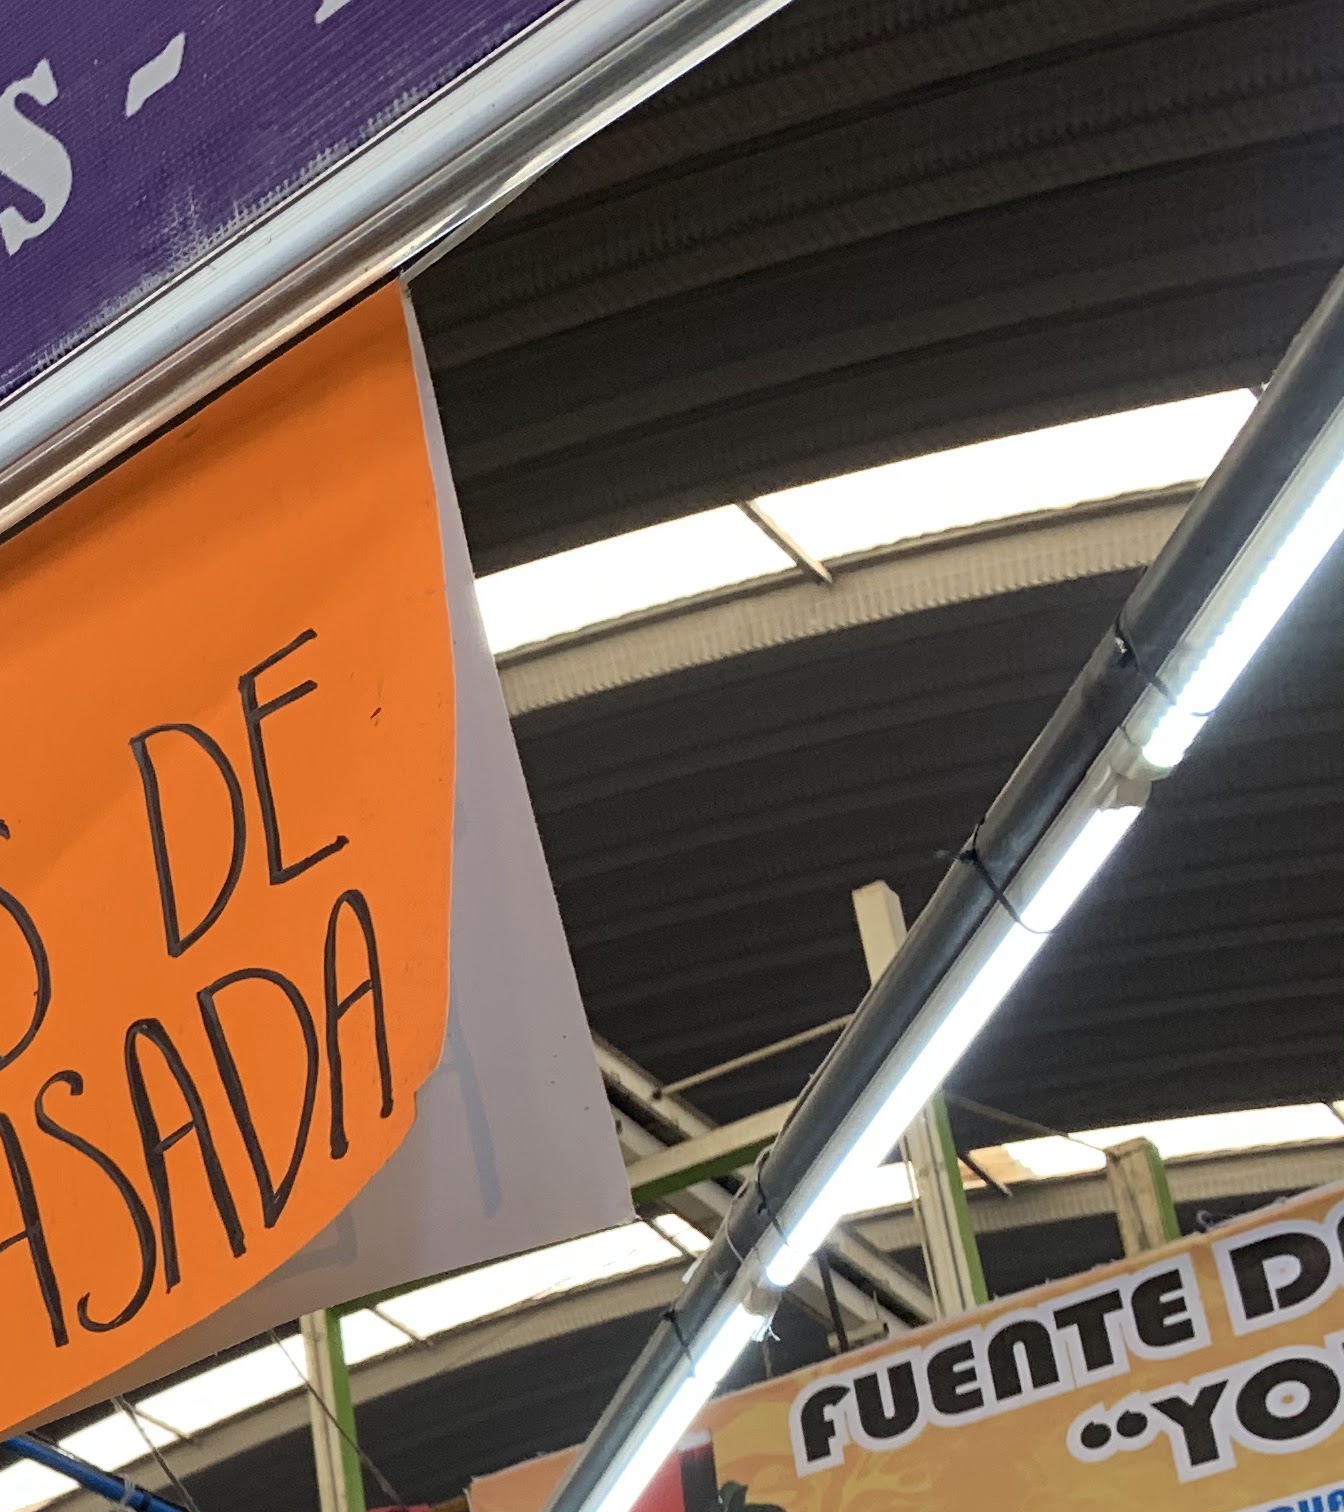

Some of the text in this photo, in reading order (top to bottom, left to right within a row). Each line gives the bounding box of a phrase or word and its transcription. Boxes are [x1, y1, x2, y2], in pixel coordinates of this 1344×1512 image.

[129, 630, 351, 959] DE
[800, 1210, 1344, 1464] FUENTE D
[1079, 1343, 1344, 1468] "YO
